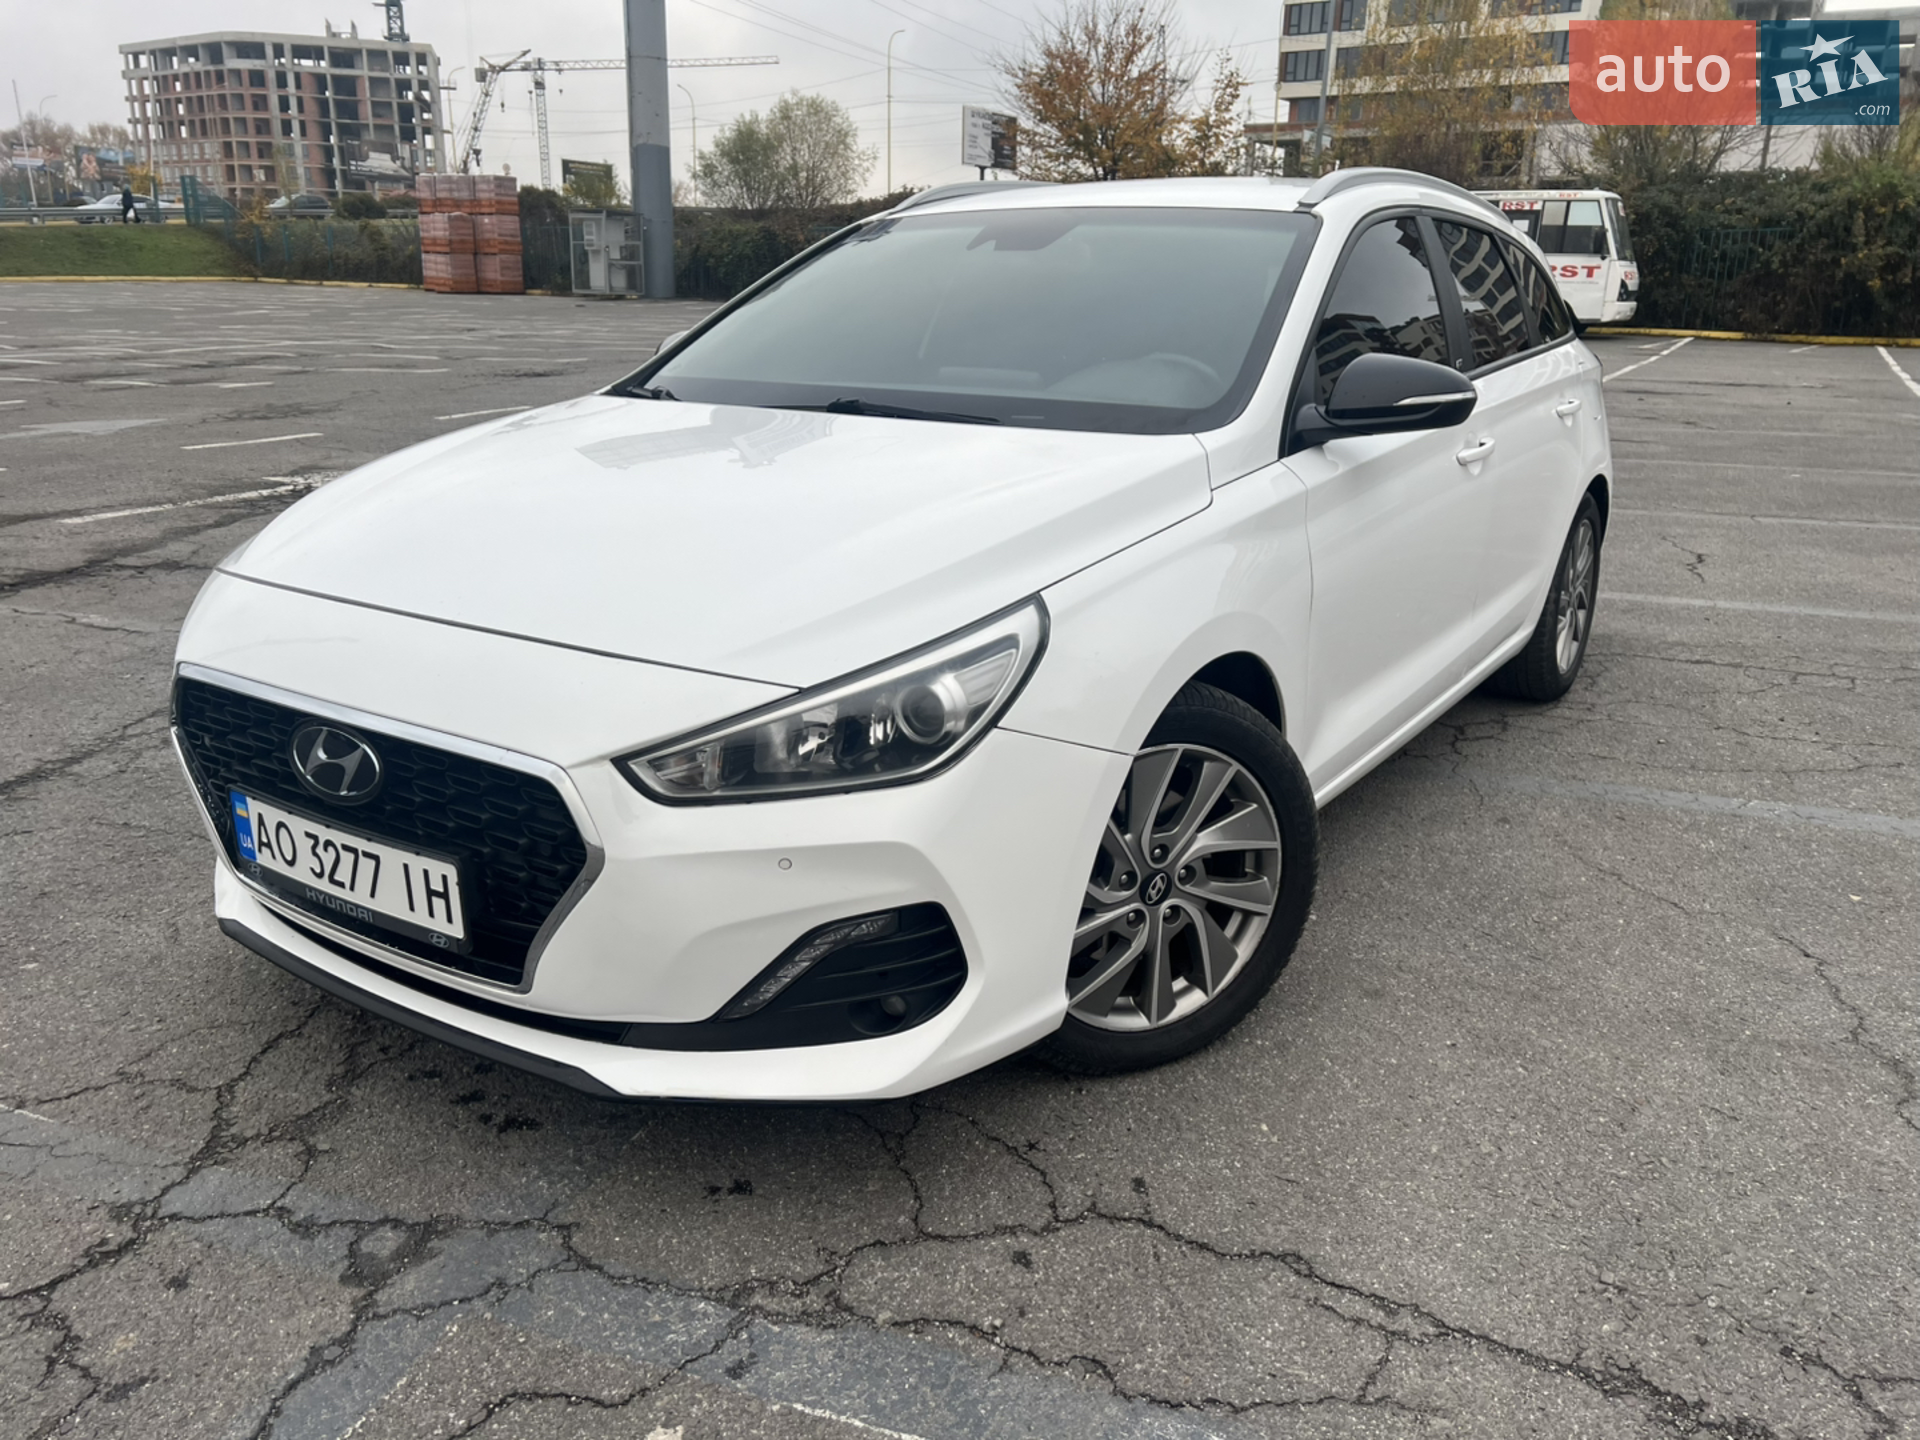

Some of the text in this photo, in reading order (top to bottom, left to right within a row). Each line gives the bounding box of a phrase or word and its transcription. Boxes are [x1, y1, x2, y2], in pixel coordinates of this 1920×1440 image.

[1502, 201, 1538, 210] RST
[239, 832, 254, 850] UA
[257, 811, 453, 925] AO 3277 IH
[305, 887, 374, 923] HYUNDAI
